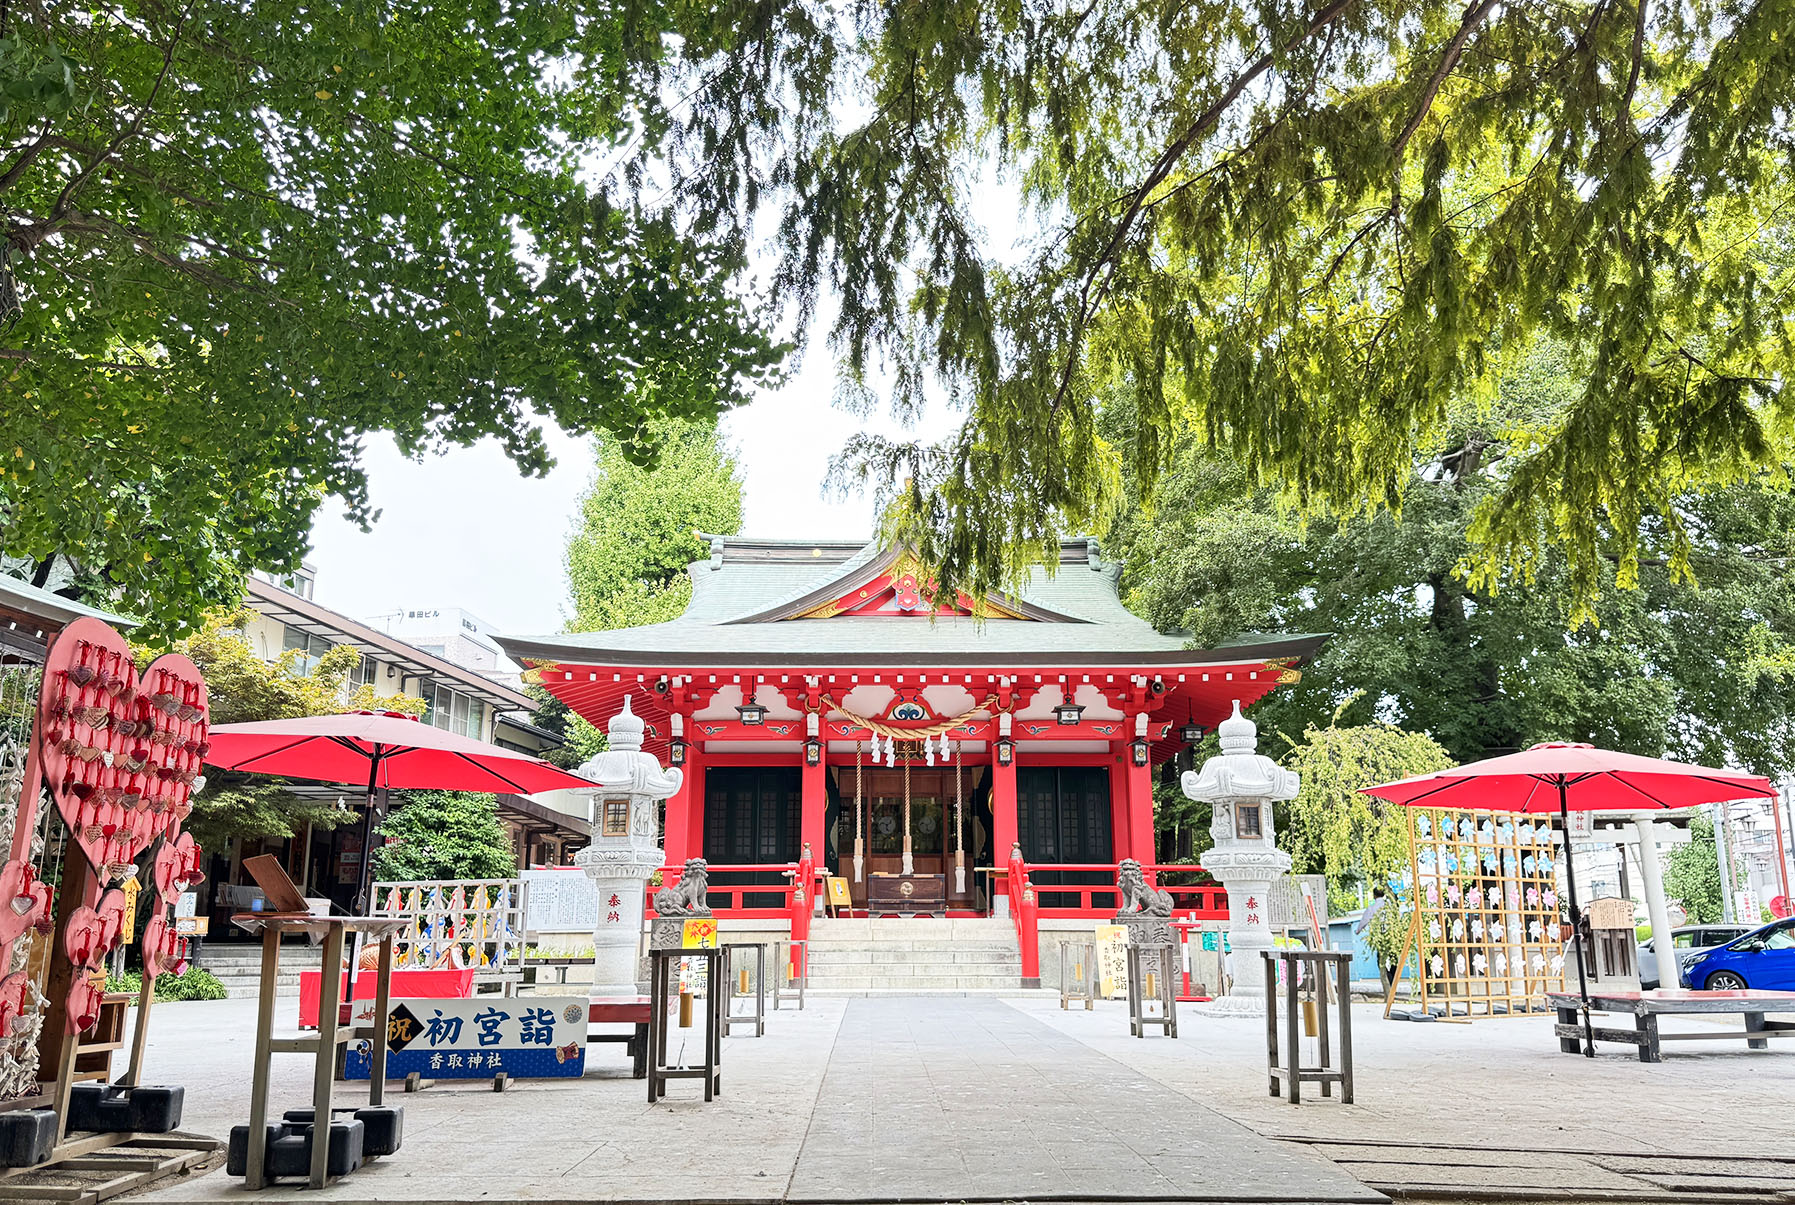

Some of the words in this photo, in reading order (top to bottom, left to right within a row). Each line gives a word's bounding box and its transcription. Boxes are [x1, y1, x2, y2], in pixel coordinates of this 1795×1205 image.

[126, 888, 134, 939] 水みくじ
[607, 893, 621, 923] 奉納
[1246, 896, 1259, 925] 奉納
[1111, 940, 1127, 991] 初宮詣
[388, 1014, 412, 1042] 祝
[424, 1007, 556, 1046] 初宮詣
[429, 1052, 503, 1070] 香取神社
